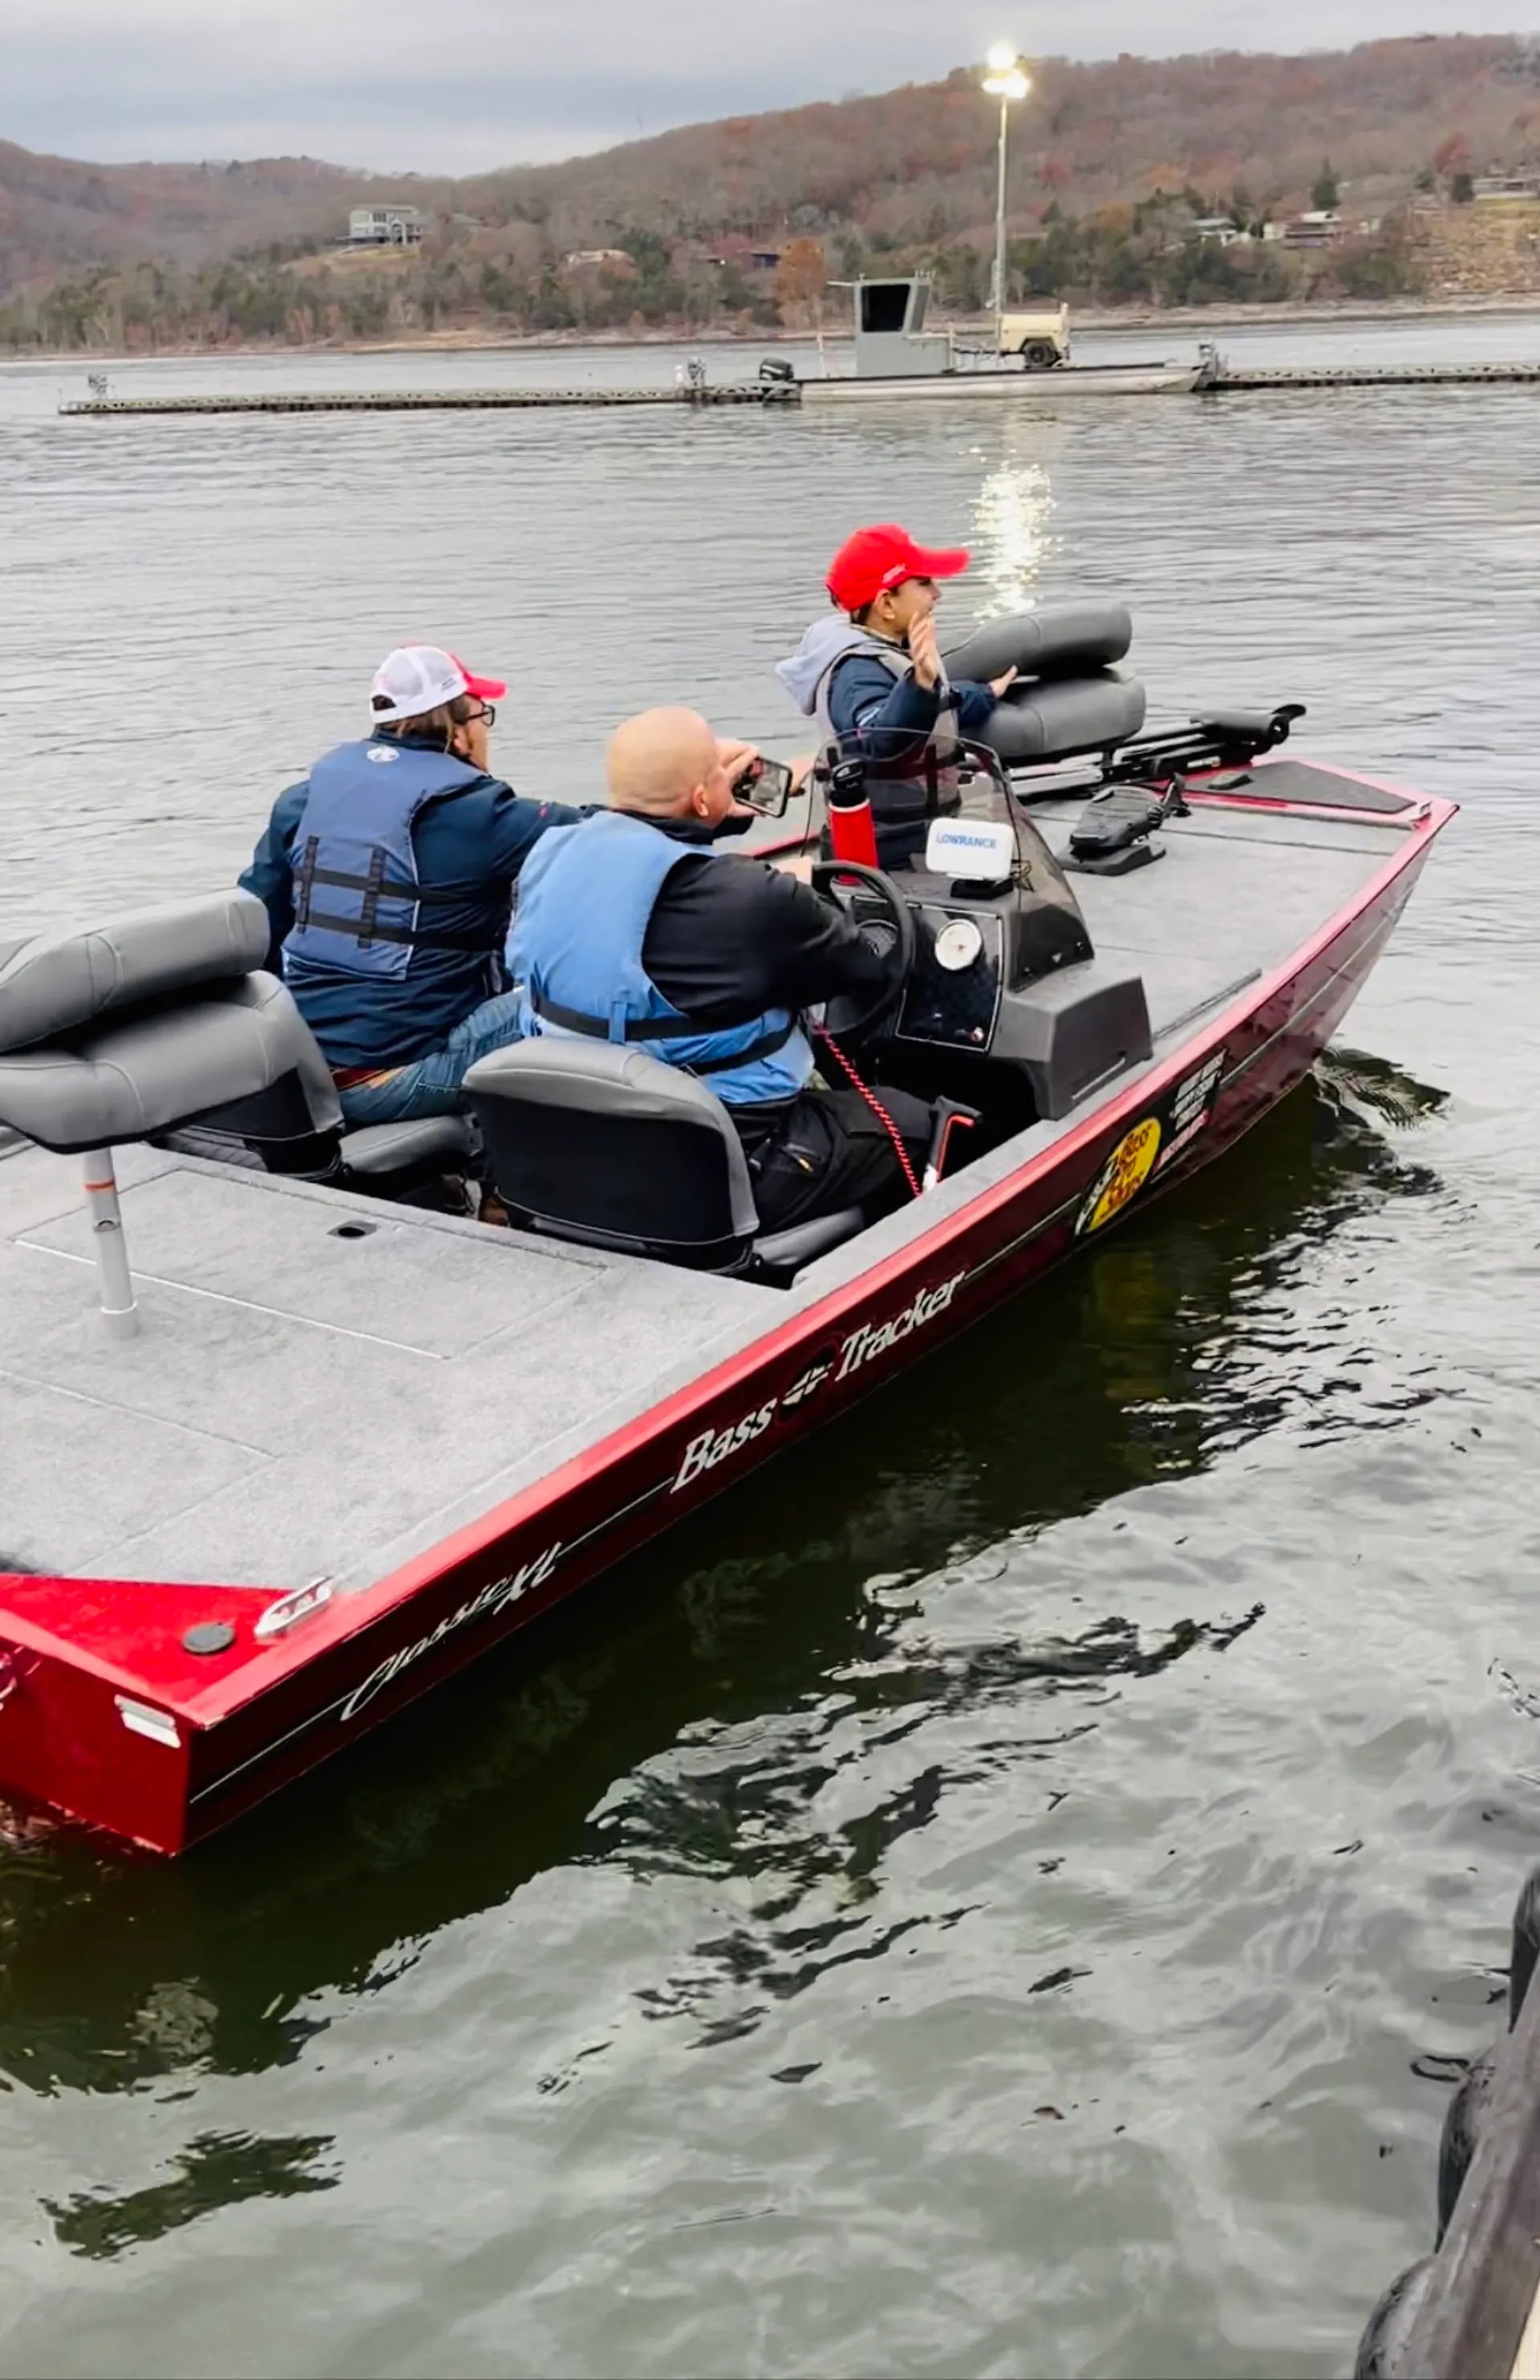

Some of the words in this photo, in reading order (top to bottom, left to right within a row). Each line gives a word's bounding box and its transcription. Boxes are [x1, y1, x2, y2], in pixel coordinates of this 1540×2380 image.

[935, 832, 997, 849] LOWRANCE
[670, 1397, 778, 1494] Bass
[834, 1271, 966, 1382] Tracker
[340, 1575, 513, 1721] Classic
